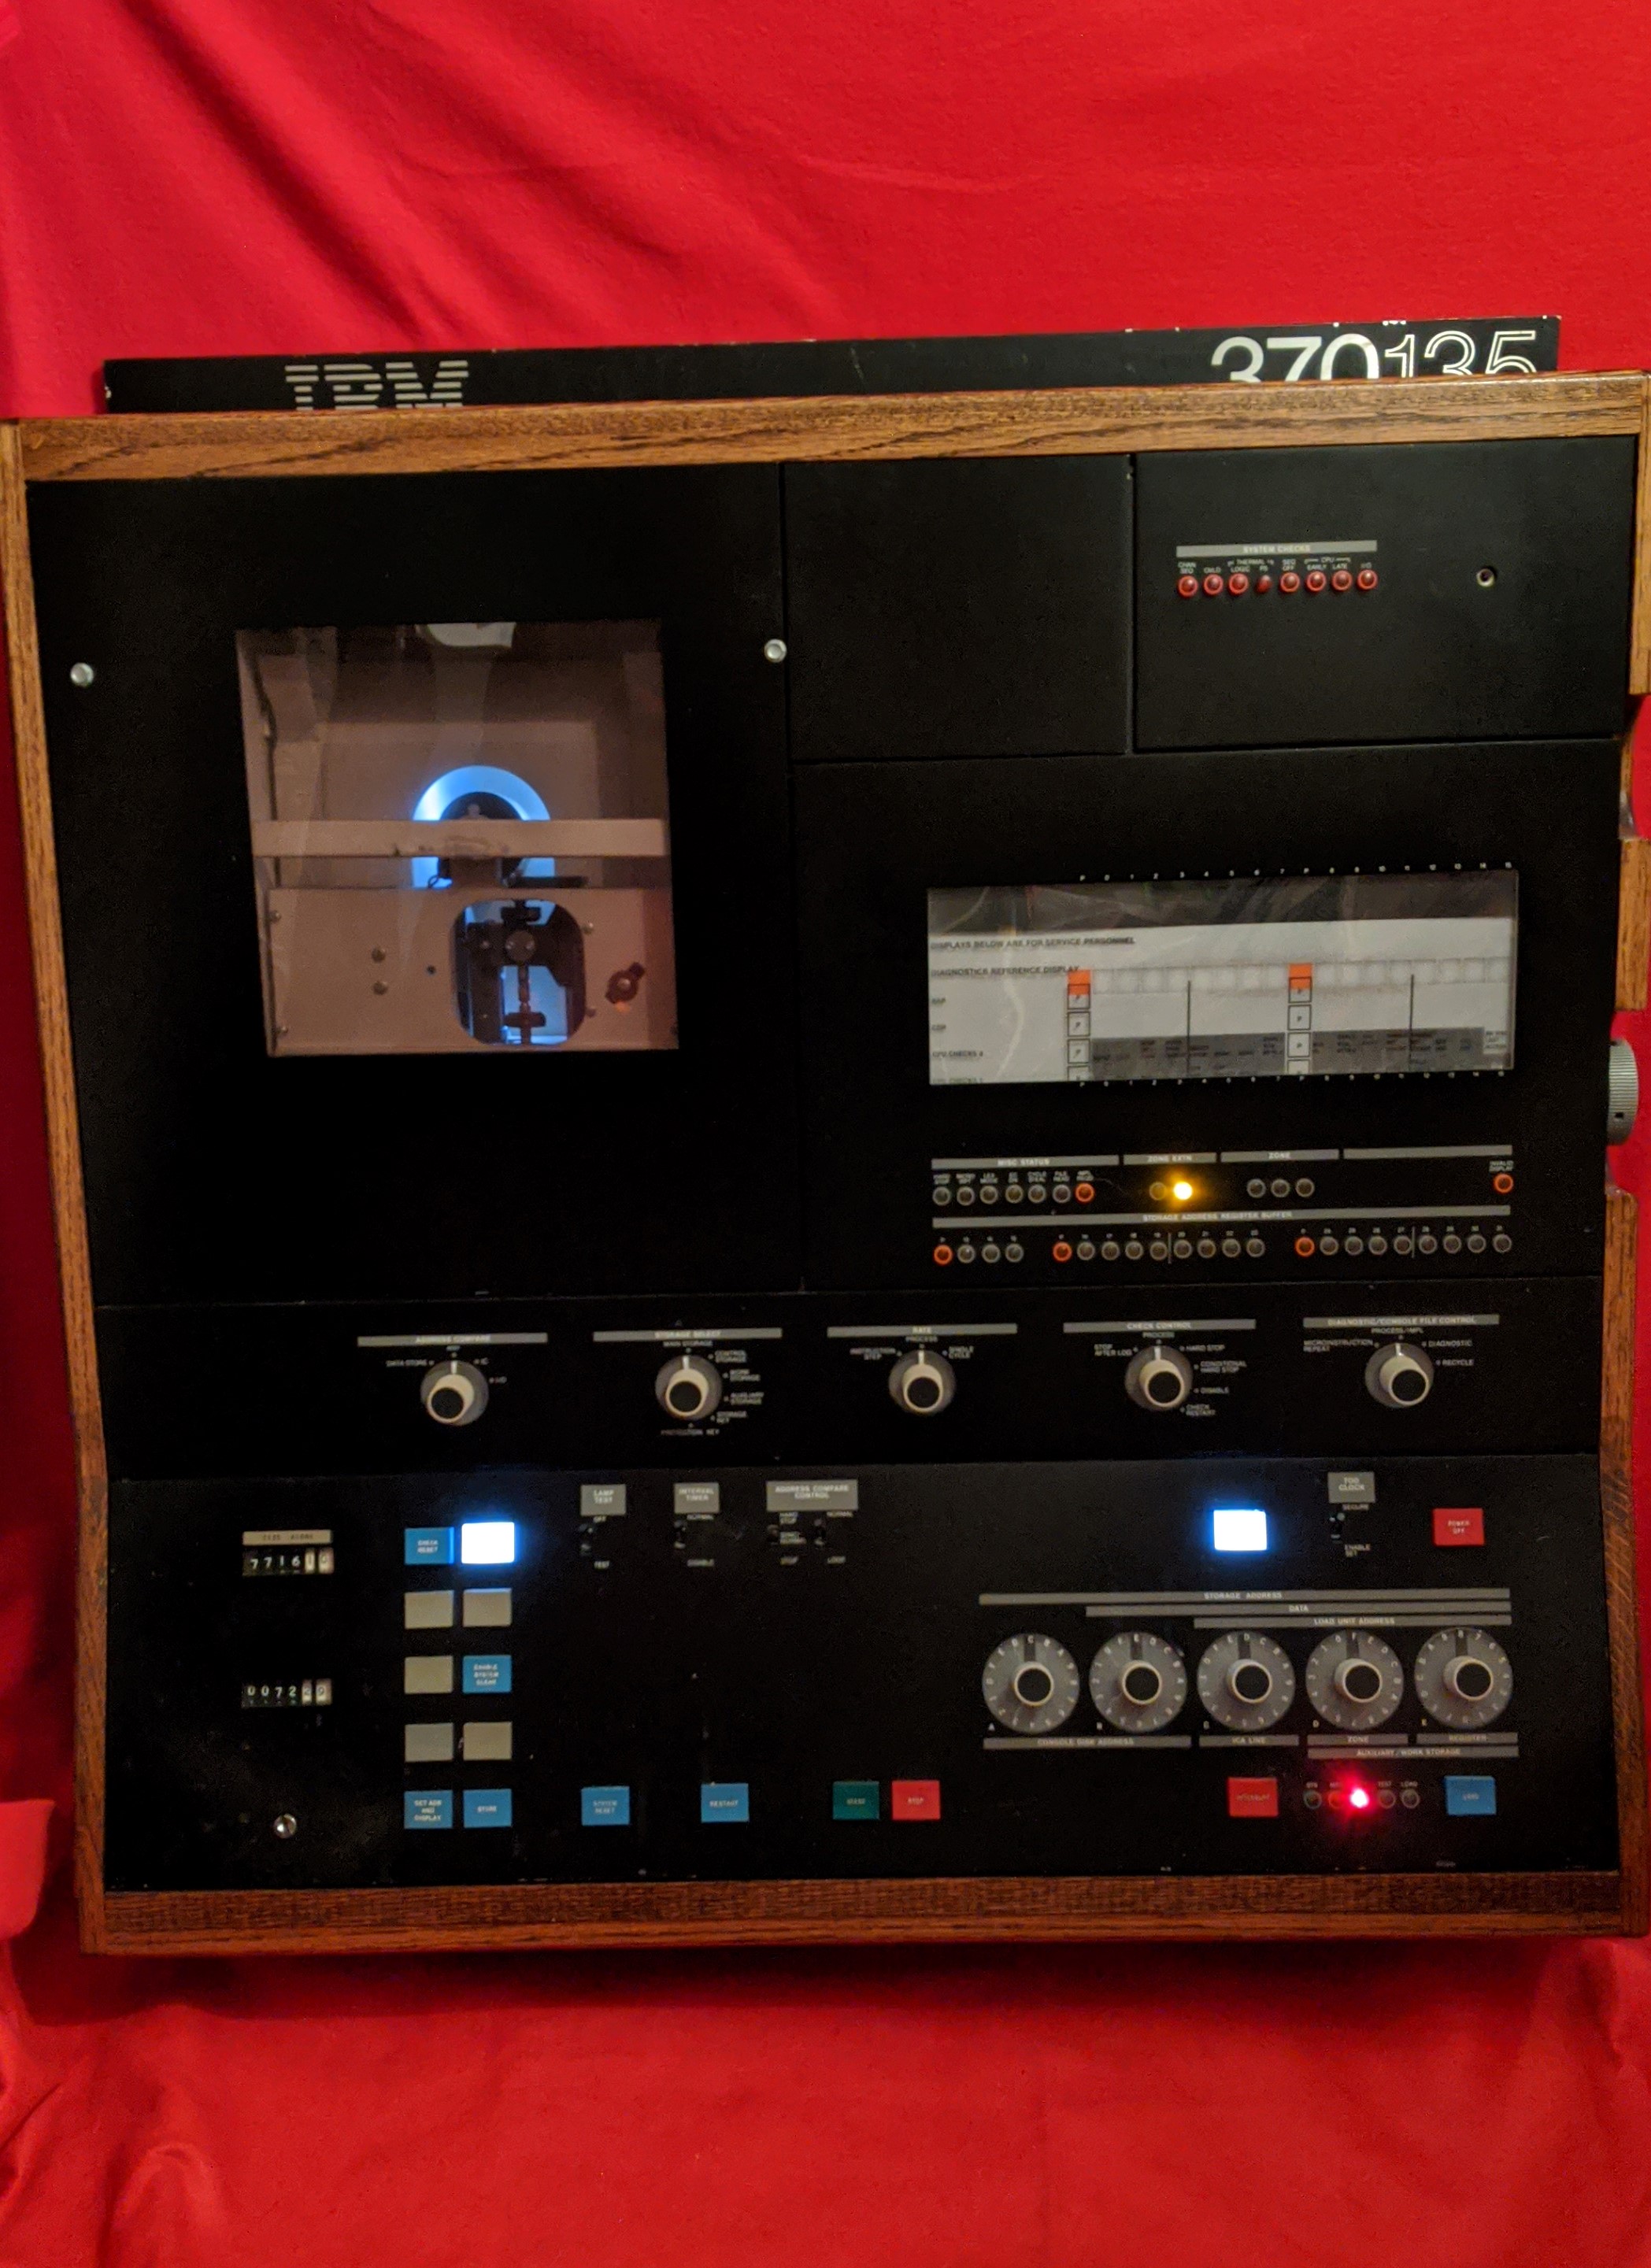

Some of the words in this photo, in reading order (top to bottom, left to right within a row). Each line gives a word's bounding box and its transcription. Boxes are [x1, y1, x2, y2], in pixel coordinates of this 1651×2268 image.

[284, 359, 470, 410] IBM
[1277, 544, 1311, 553] CHECKS
[931, 942, 971, 950] DISPLAYS
[1083, 937, 1135, 945] PERSONNEL
[991, 967, 1040, 975] REFERENCE
[1439, 1315, 1476, 1324] CONTROL
[1204, 1592, 1241, 1600] STORAGE
[1246, 1591, 1283, 1600] ADDRESS
